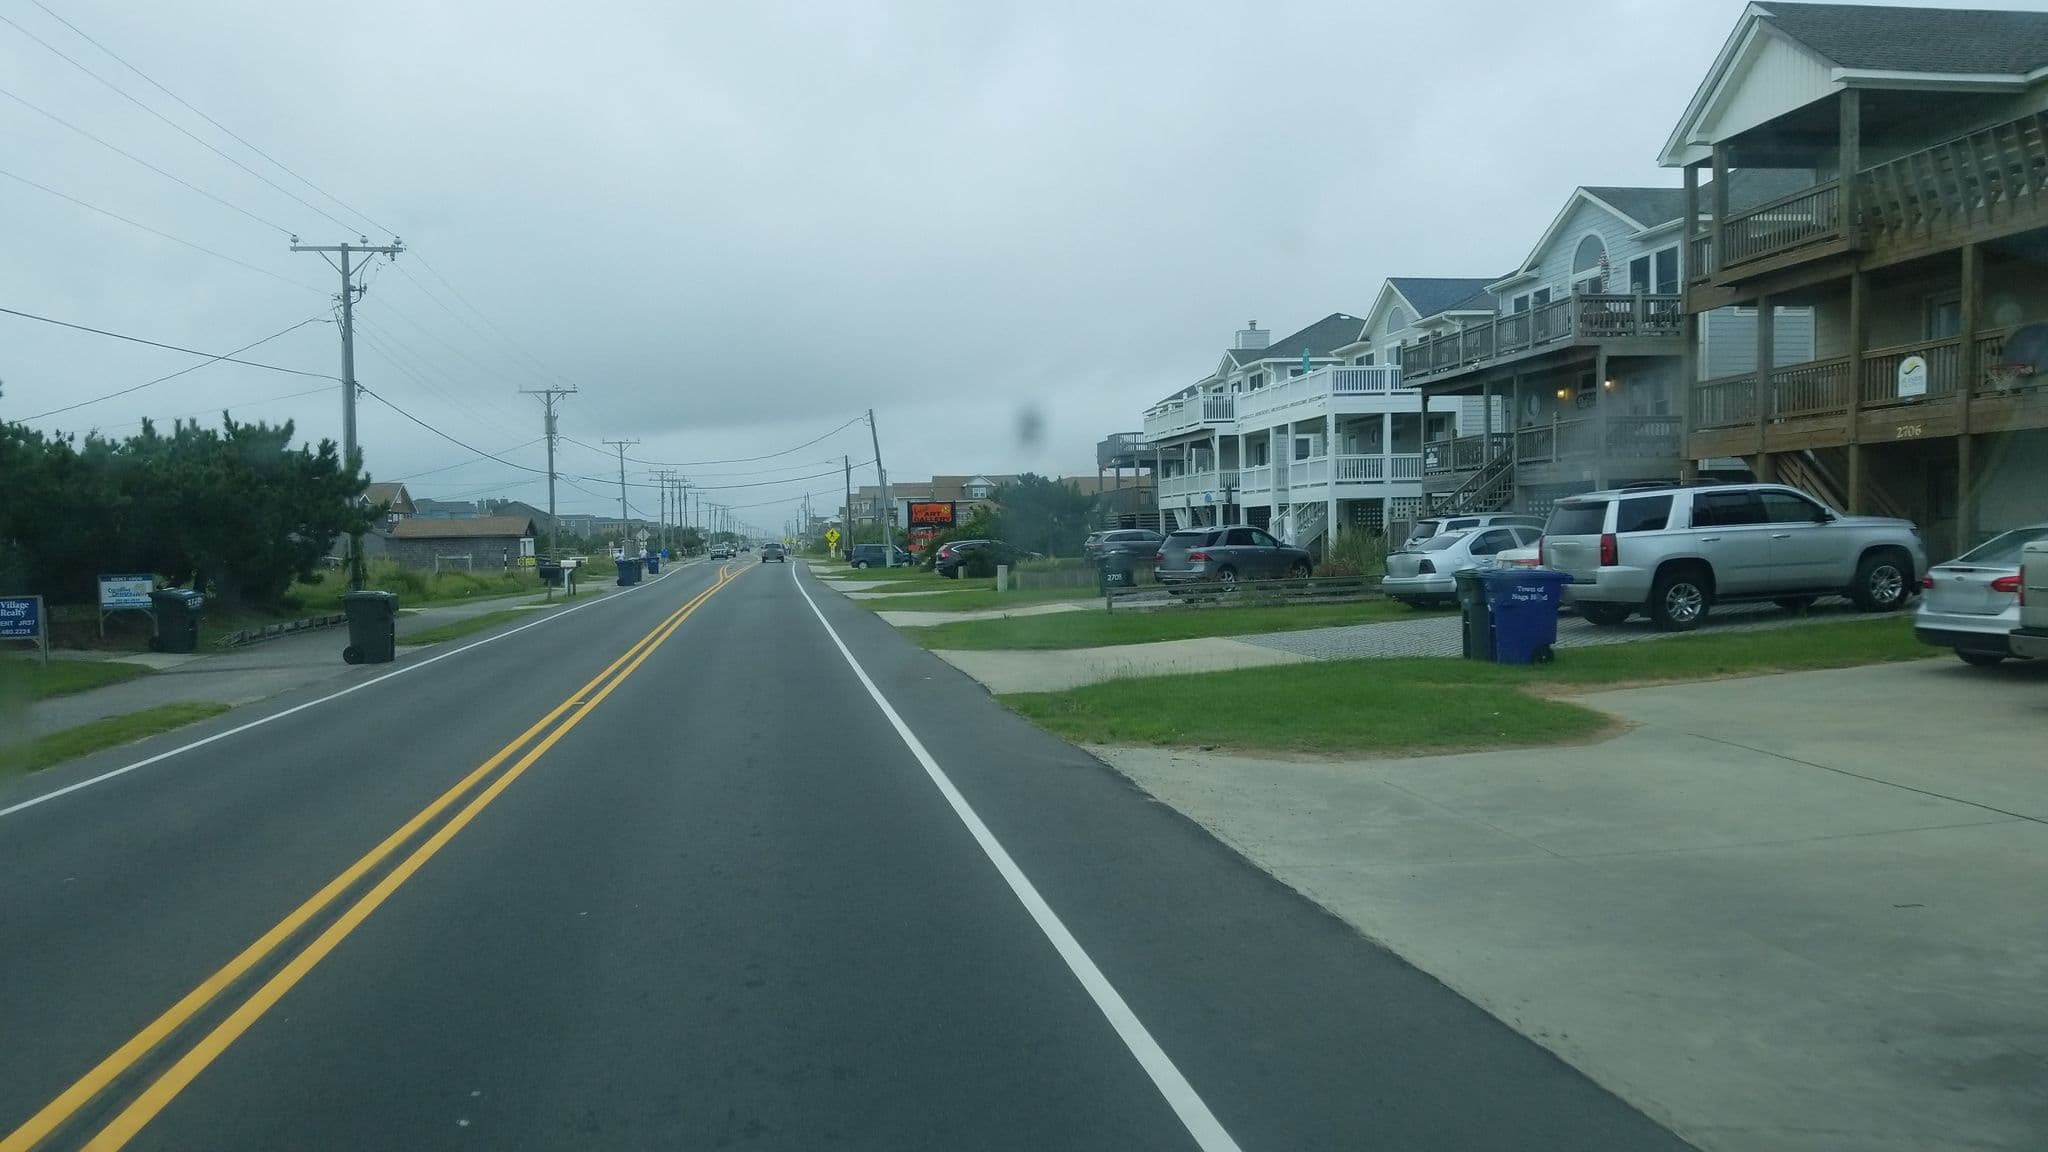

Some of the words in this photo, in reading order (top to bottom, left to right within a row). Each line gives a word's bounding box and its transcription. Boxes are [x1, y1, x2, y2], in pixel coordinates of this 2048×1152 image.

[1896, 424, 1922, 439] 2706
[0, 600, 29, 610] Village
[1, 608, 27, 618] Realty
